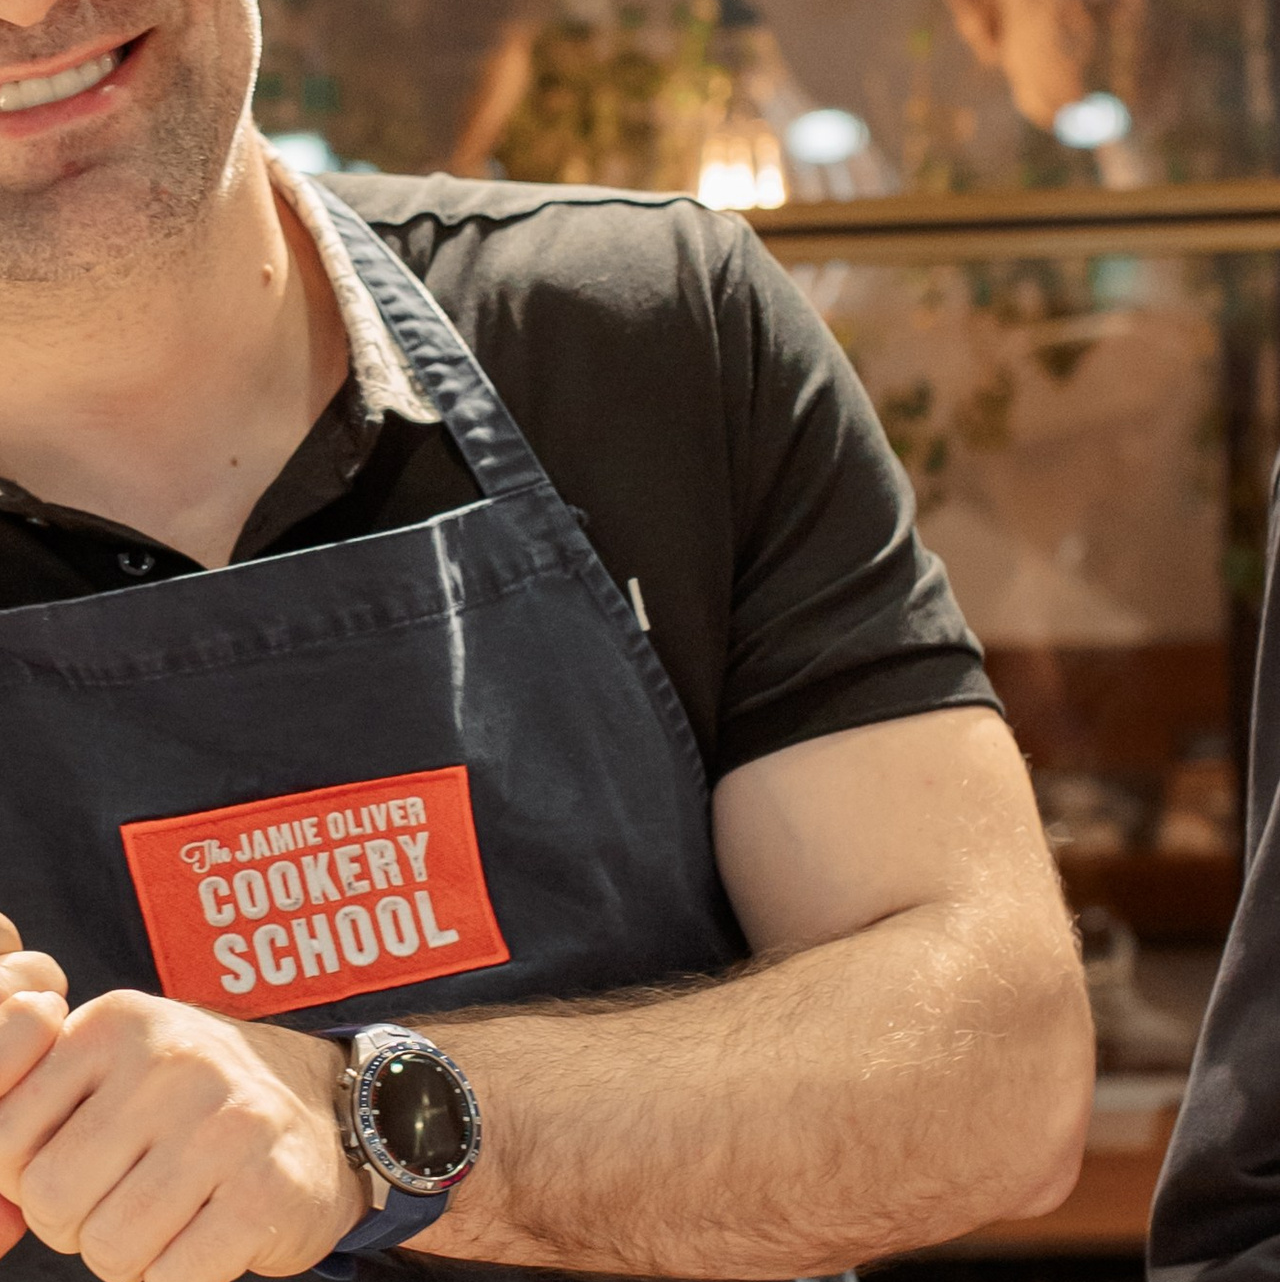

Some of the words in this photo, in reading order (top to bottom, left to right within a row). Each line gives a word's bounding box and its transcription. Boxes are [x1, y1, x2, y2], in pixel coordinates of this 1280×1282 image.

[180, 839, 232, 873] The
[234, 817, 322, 863] JAMIE
[326, 796, 427, 841] OLIVER
[198, 831, 430, 927] COOKERY
[213, 890, 460, 994] SCHOOL
